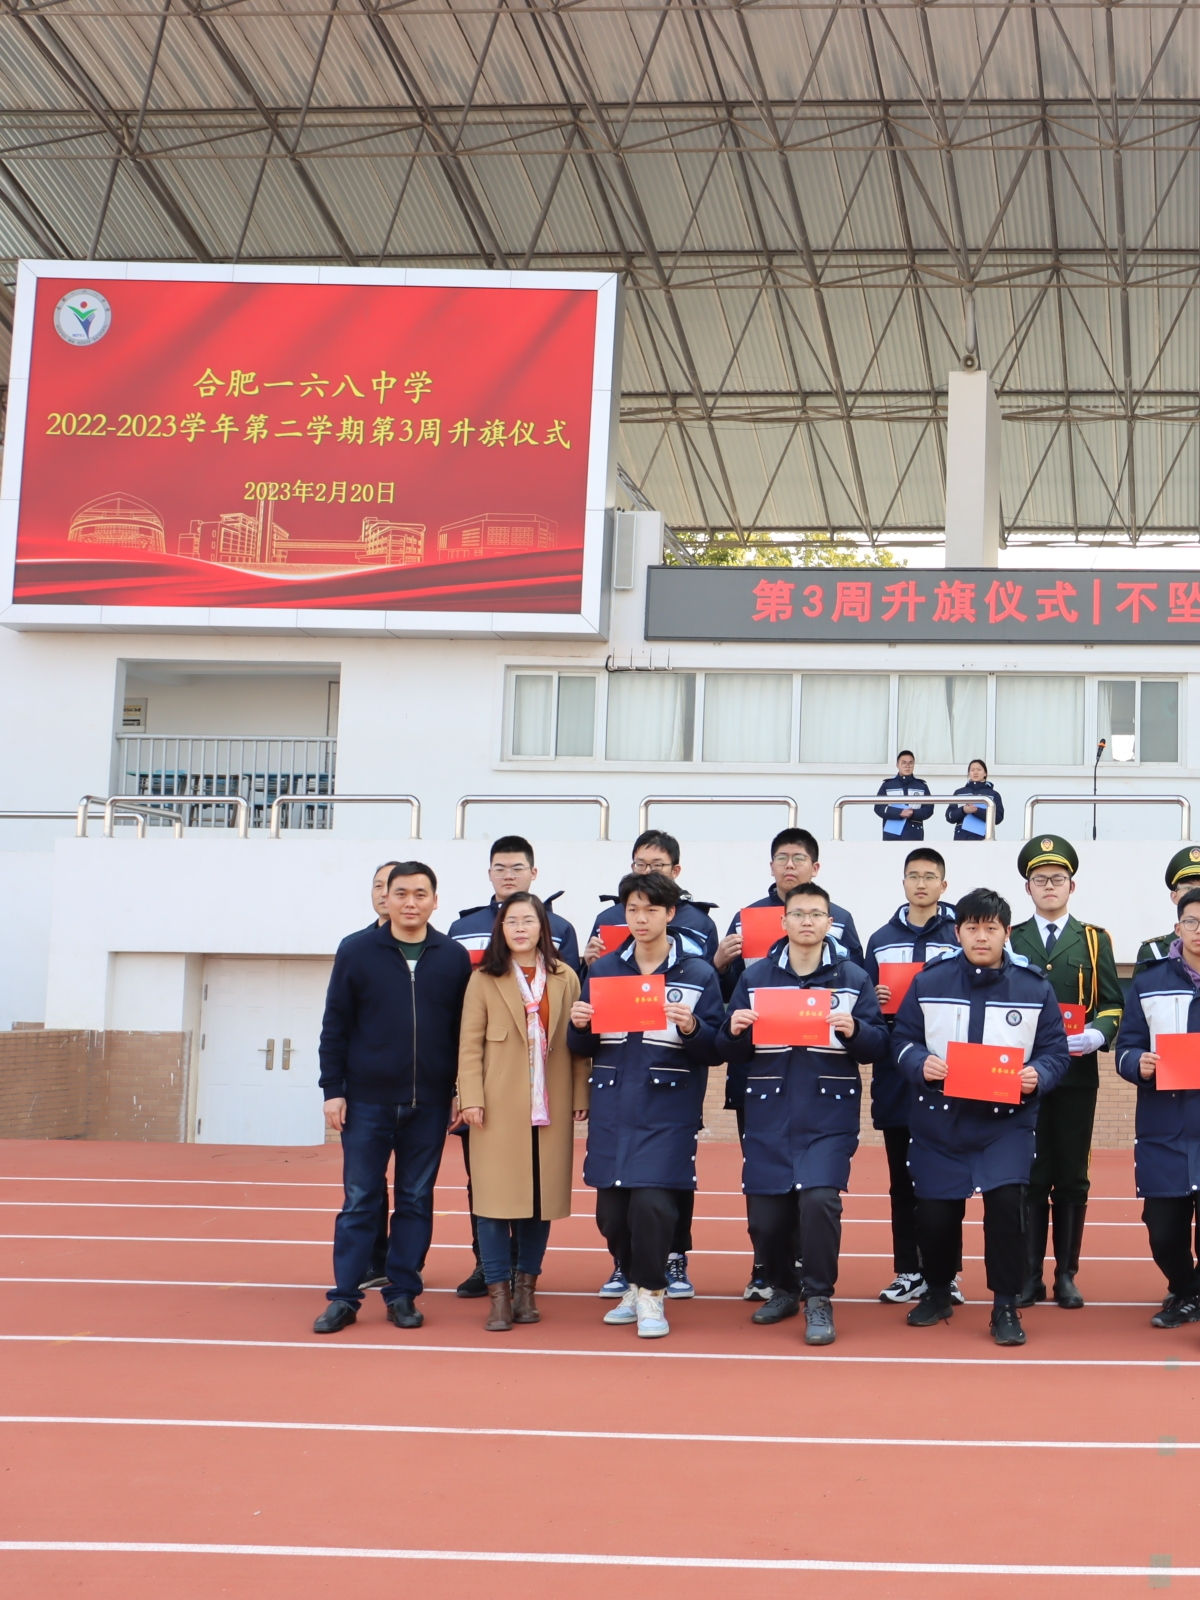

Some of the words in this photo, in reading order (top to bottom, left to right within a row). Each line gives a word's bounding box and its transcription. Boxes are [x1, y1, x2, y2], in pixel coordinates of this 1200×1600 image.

[193, 368, 433, 404] 合肥一六八中学
[45, 411, 571, 451] 2022-2023学年第二学期第3周升旗仪式
[244, 480, 395, 504] 2023年2月20日
